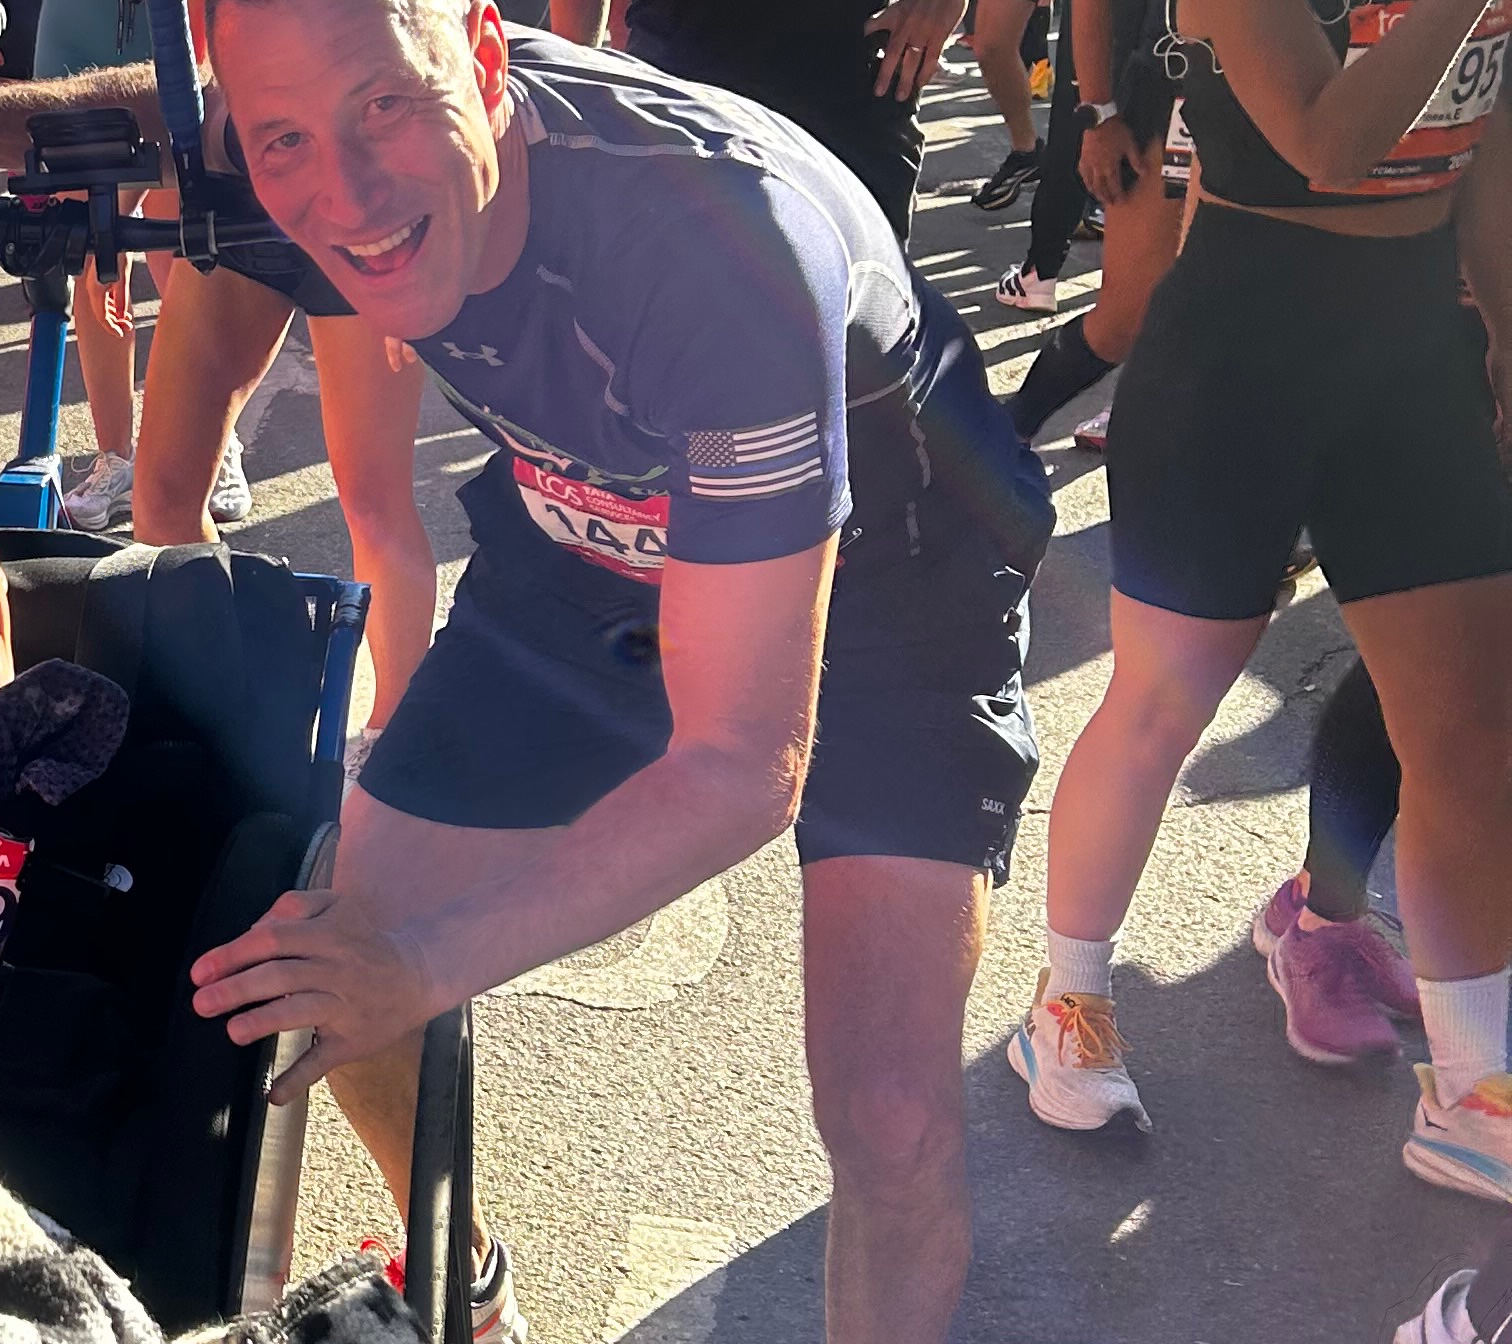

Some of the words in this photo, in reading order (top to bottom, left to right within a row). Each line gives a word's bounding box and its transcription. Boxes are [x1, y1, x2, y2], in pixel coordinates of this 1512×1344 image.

[535, 467, 584, 506] tcs
[583, 486, 616, 502] TATA
[586, 497, 661, 522] CONSULTANCY
[981, 797, 1005, 815] SAXX
